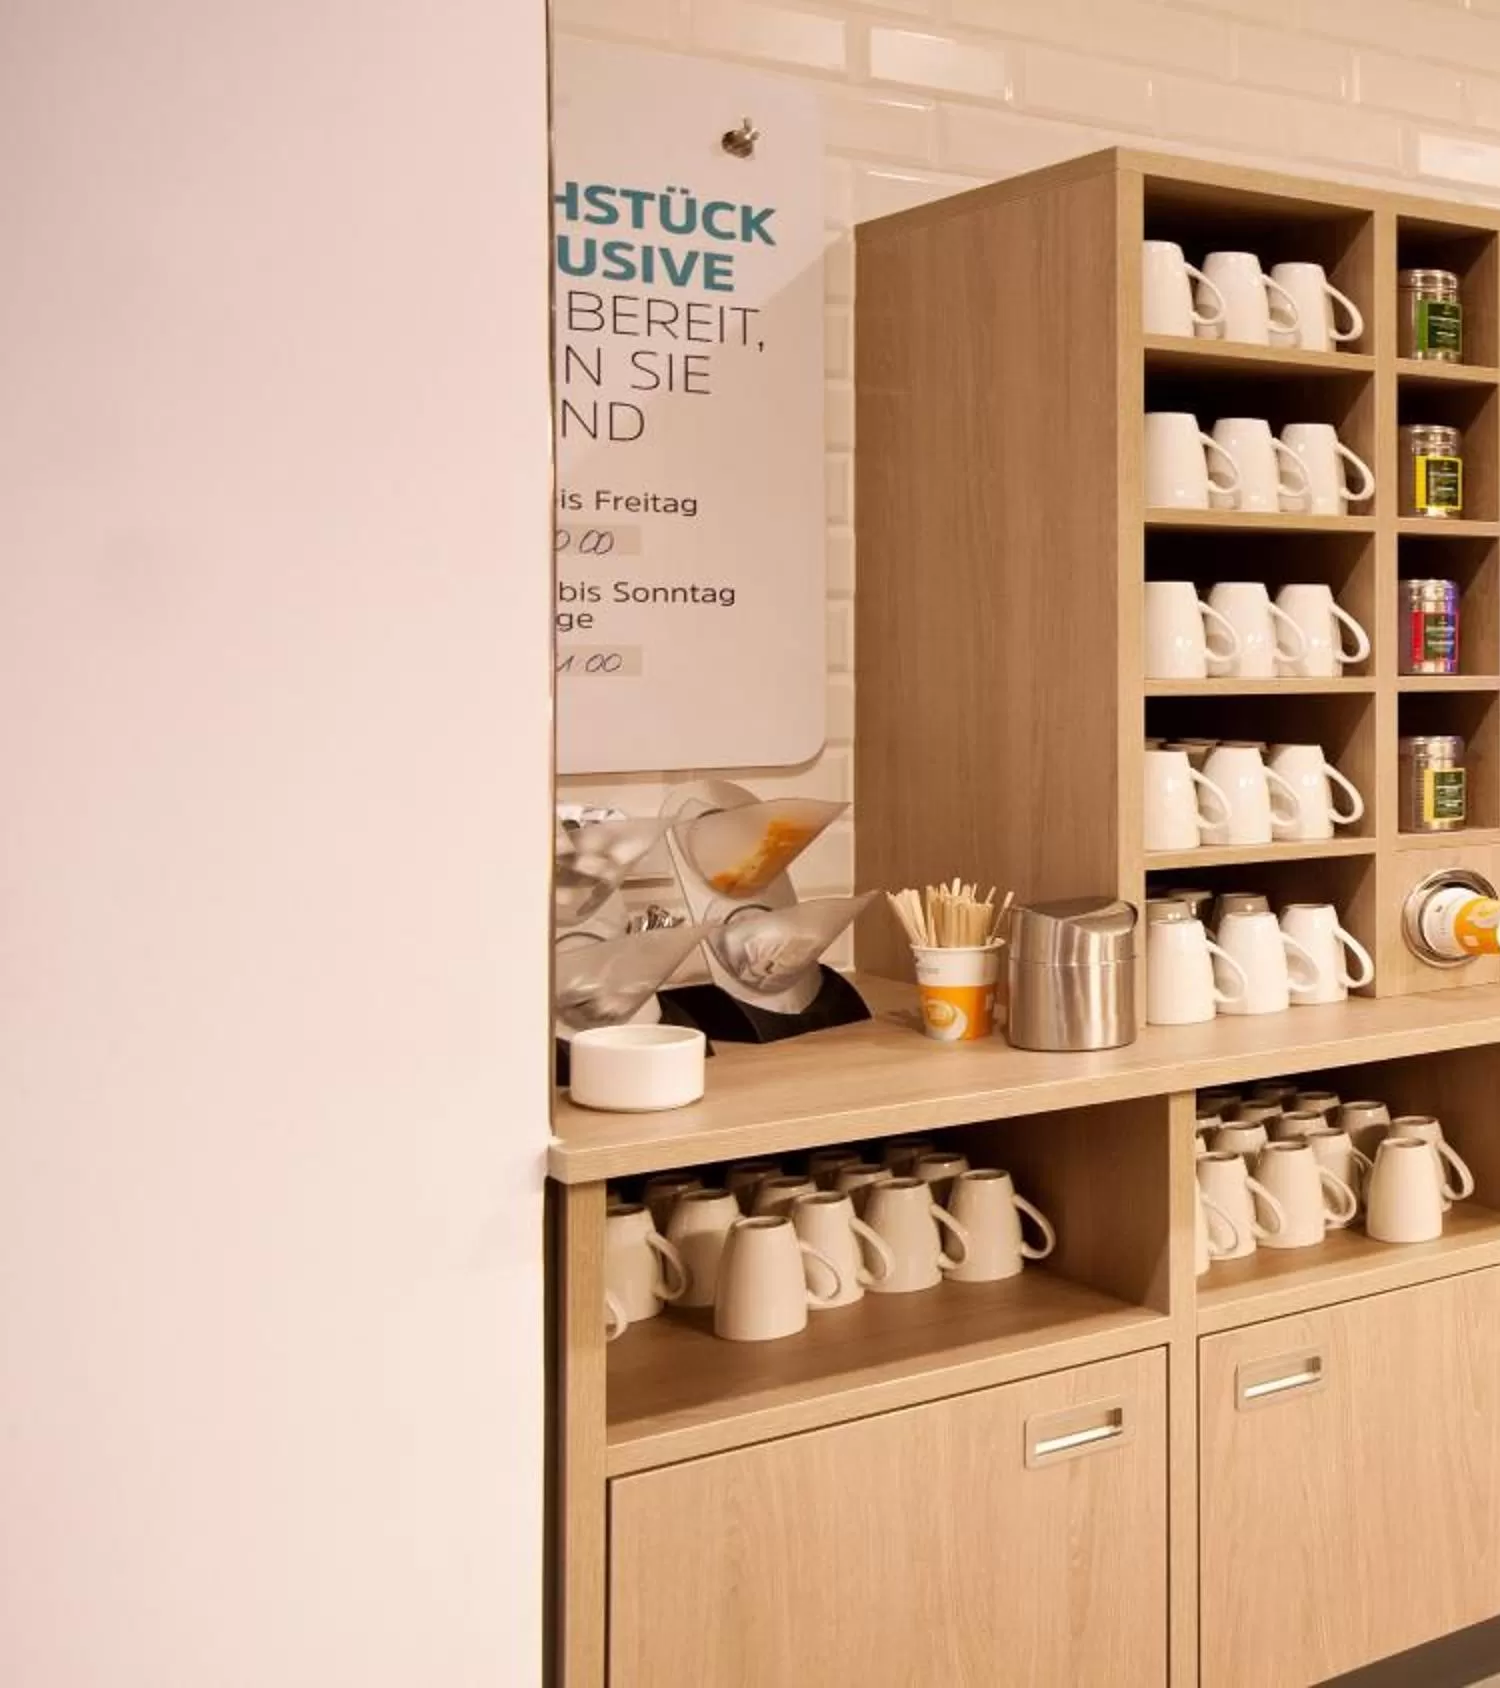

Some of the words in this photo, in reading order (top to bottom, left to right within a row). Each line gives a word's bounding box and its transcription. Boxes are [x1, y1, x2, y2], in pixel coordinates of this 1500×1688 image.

[556, 235, 735, 292] USIVE
[567, 290, 764, 353] BEREIT,
[564, 344, 601, 386] N
[631, 350, 712, 395] SIE
[561, 398, 644, 441] ND
[560, 489, 583, 511] is
[595, 490, 697, 517] Freitag
[558, 582, 601, 603] bis
[613, 582, 736, 607] Sonntag
